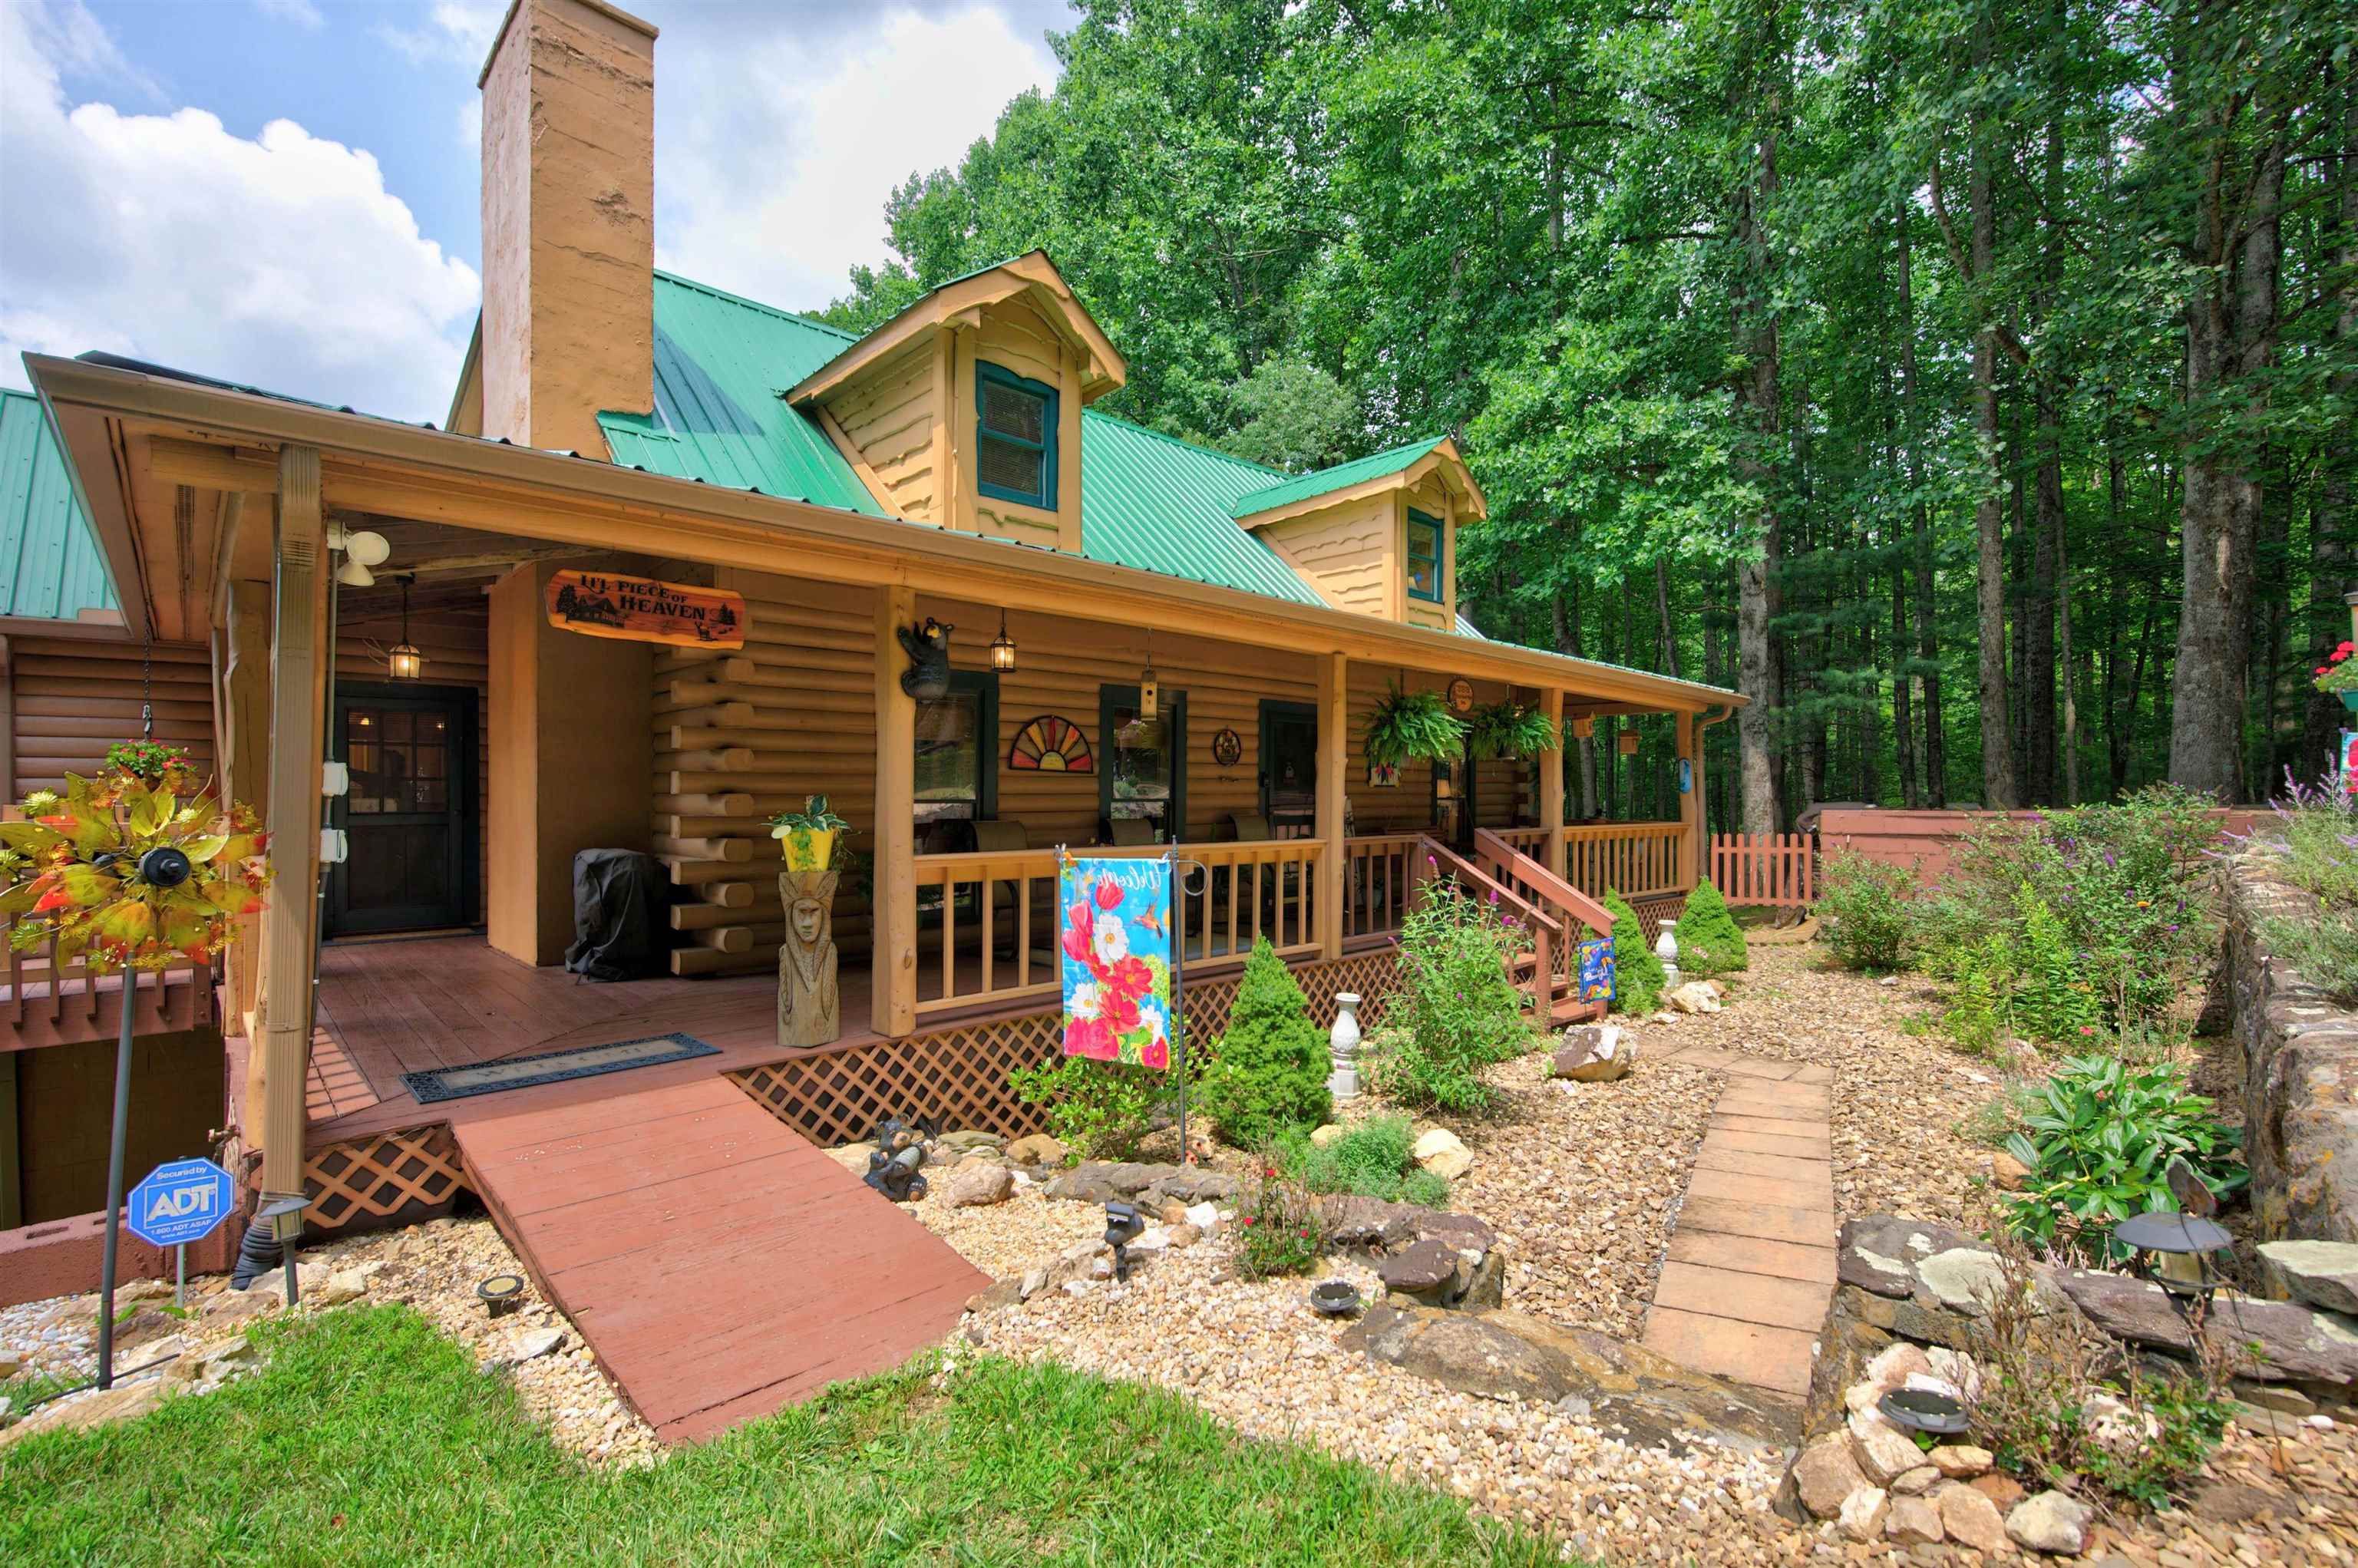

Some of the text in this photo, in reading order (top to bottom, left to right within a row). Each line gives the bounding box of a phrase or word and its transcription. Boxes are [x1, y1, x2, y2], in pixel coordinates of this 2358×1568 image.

[618, 580, 670, 599] PIECE
[672, 595, 689, 604] OF
[619, 594, 706, 621] HEAVEN
[157, 1166, 207, 1180] Secured by
[147, 1183, 216, 1222] ADT
